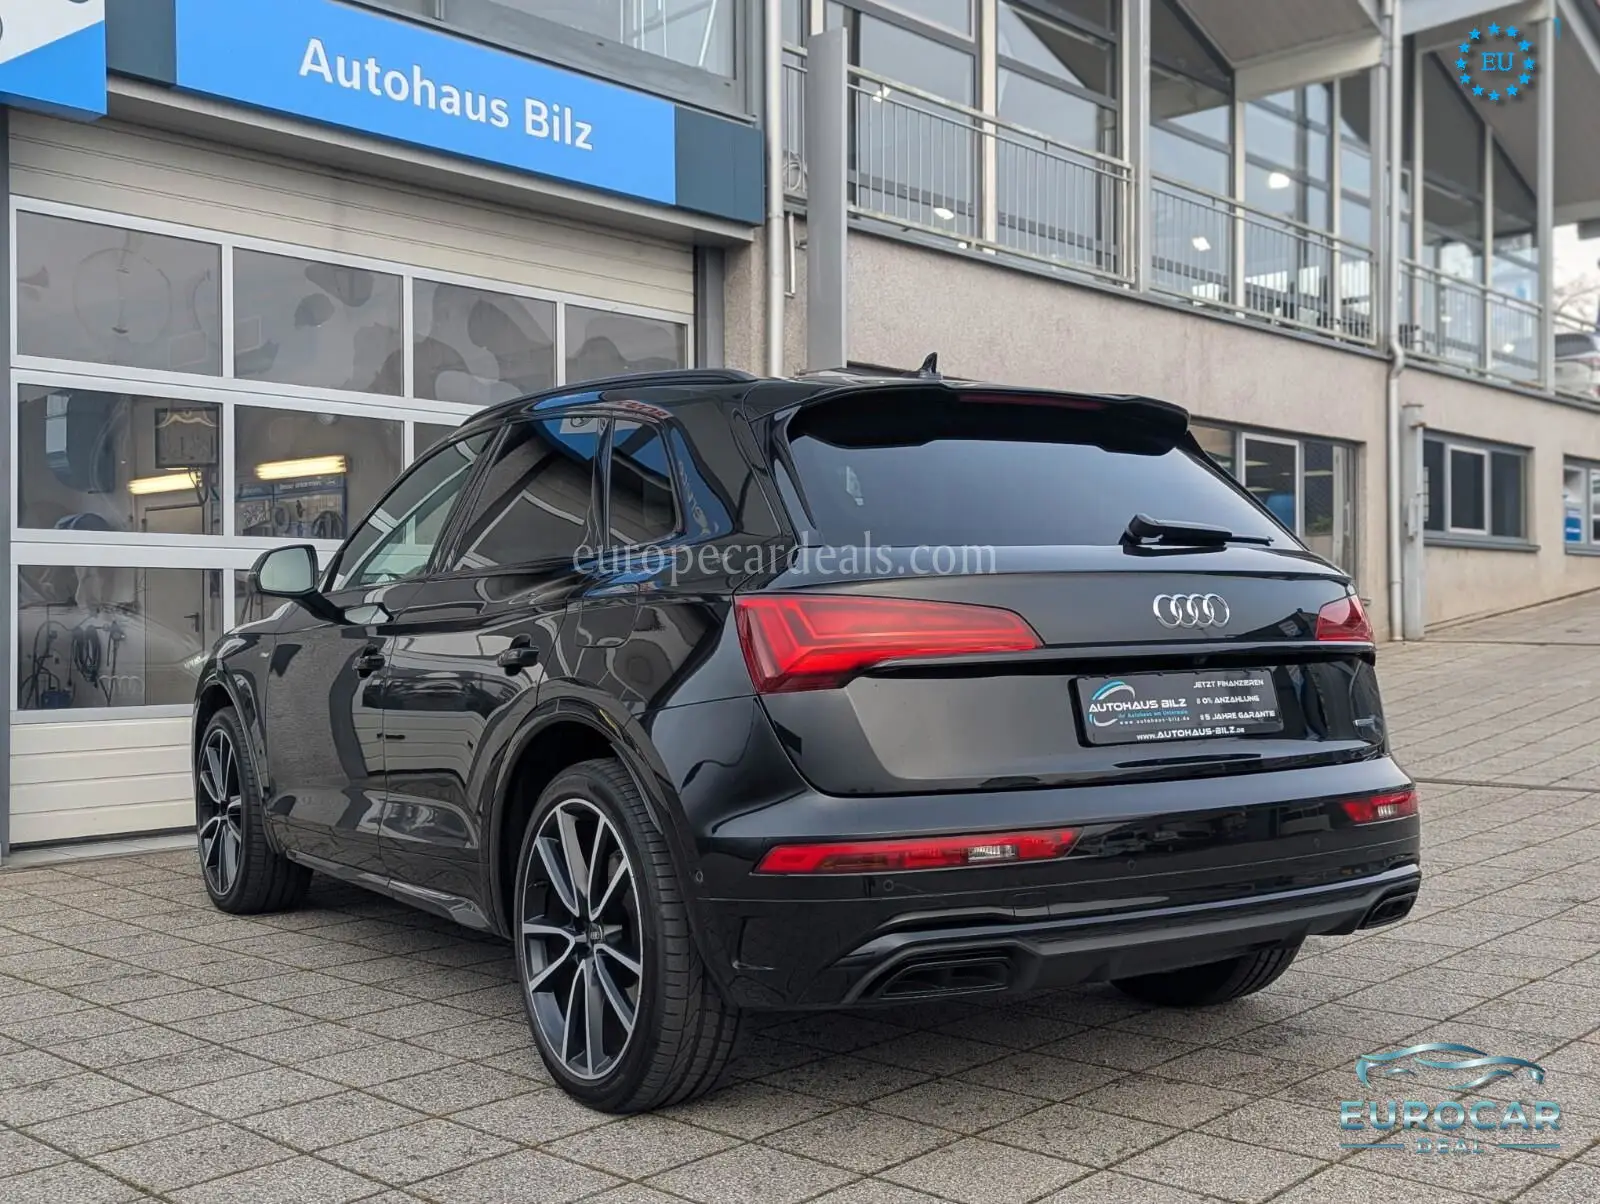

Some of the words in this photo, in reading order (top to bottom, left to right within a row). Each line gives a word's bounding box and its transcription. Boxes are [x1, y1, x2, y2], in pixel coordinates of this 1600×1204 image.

[299, 37, 510, 128] Autohaus
[524, 97, 594, 150] Bilz
[1193, 681, 1216, 689] JETZT
[1216, 679, 1265, 688] FINANZIEREN
[1214, 695, 1260, 704] ANZAHLUNG
[1088, 700, 1159, 713] AUTOHAUS
[1161, 698, 1188, 709] BILZ
[1212, 712, 1237, 720] JAHRE
[1238, 710, 1276, 719] GARANTIE
